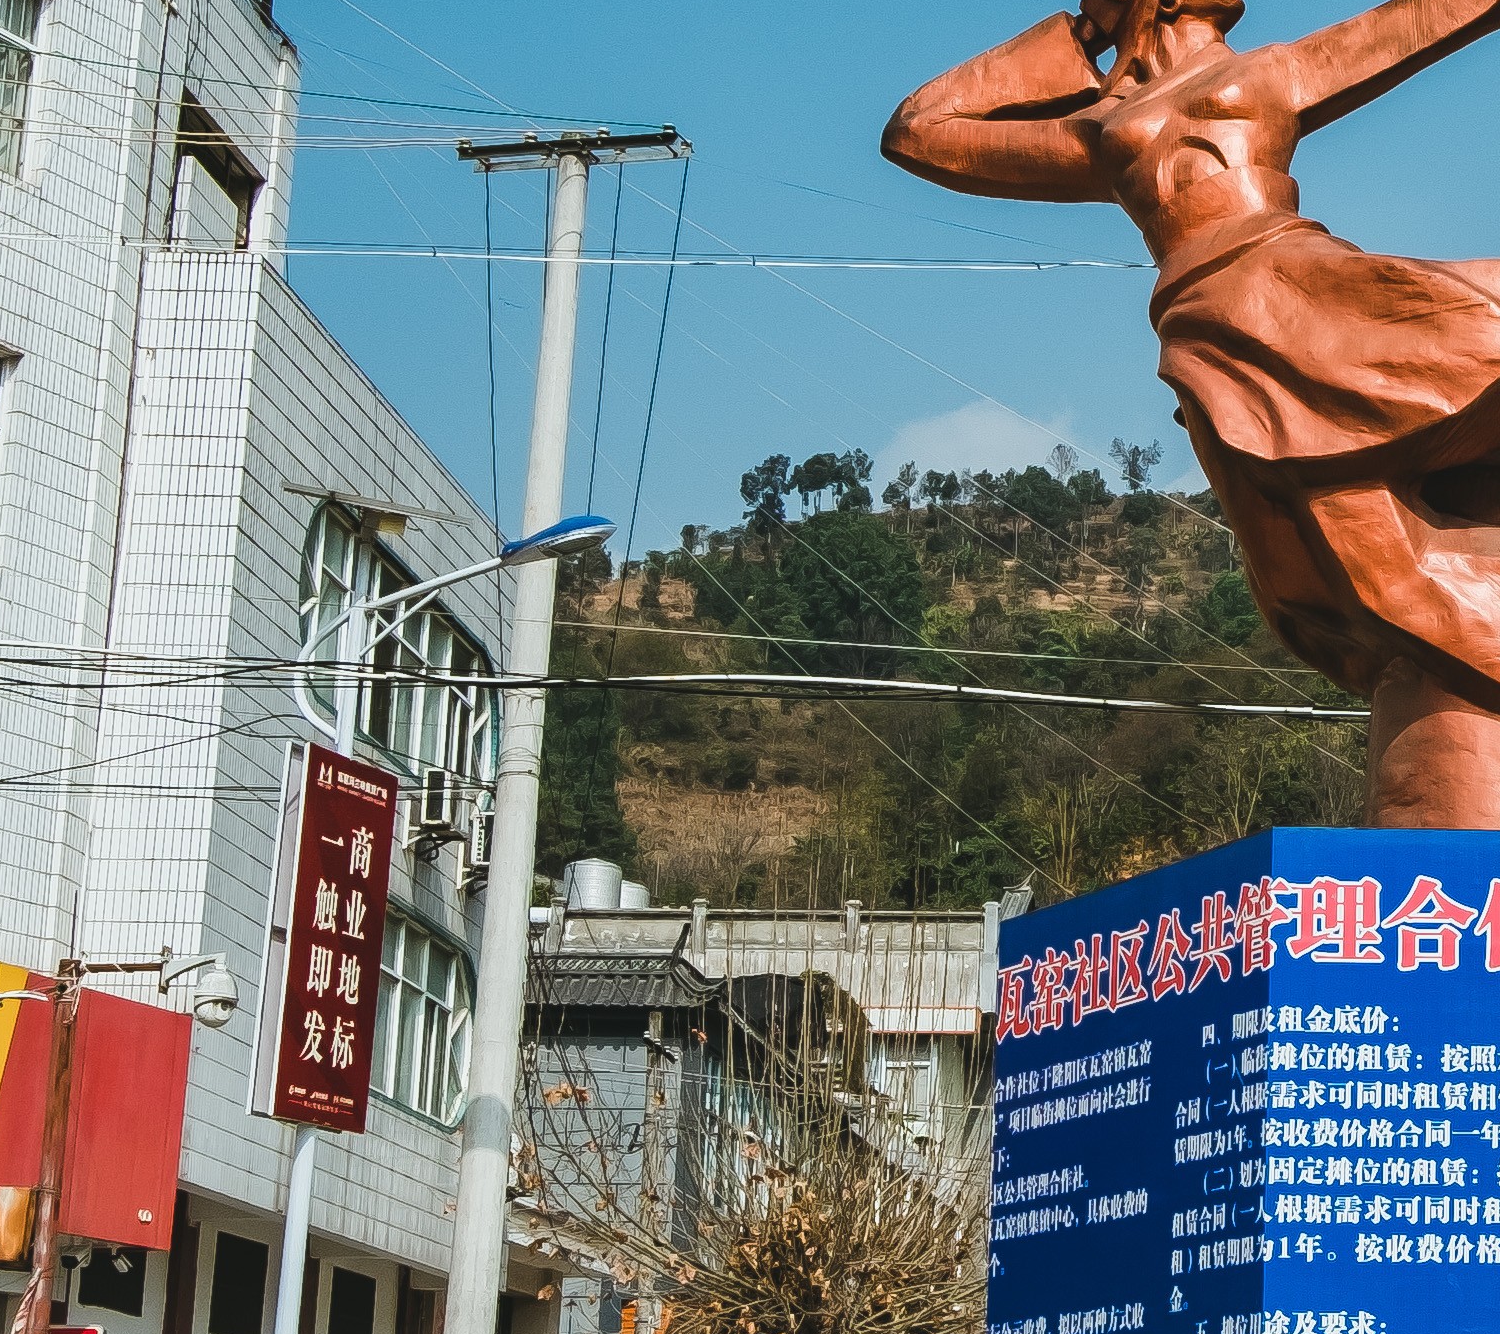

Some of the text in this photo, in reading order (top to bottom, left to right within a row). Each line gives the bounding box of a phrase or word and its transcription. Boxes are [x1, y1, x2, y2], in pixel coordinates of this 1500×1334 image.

[299, 833, 345, 1065] 一触即发
[329, 825, 375, 1070] 商业地标
